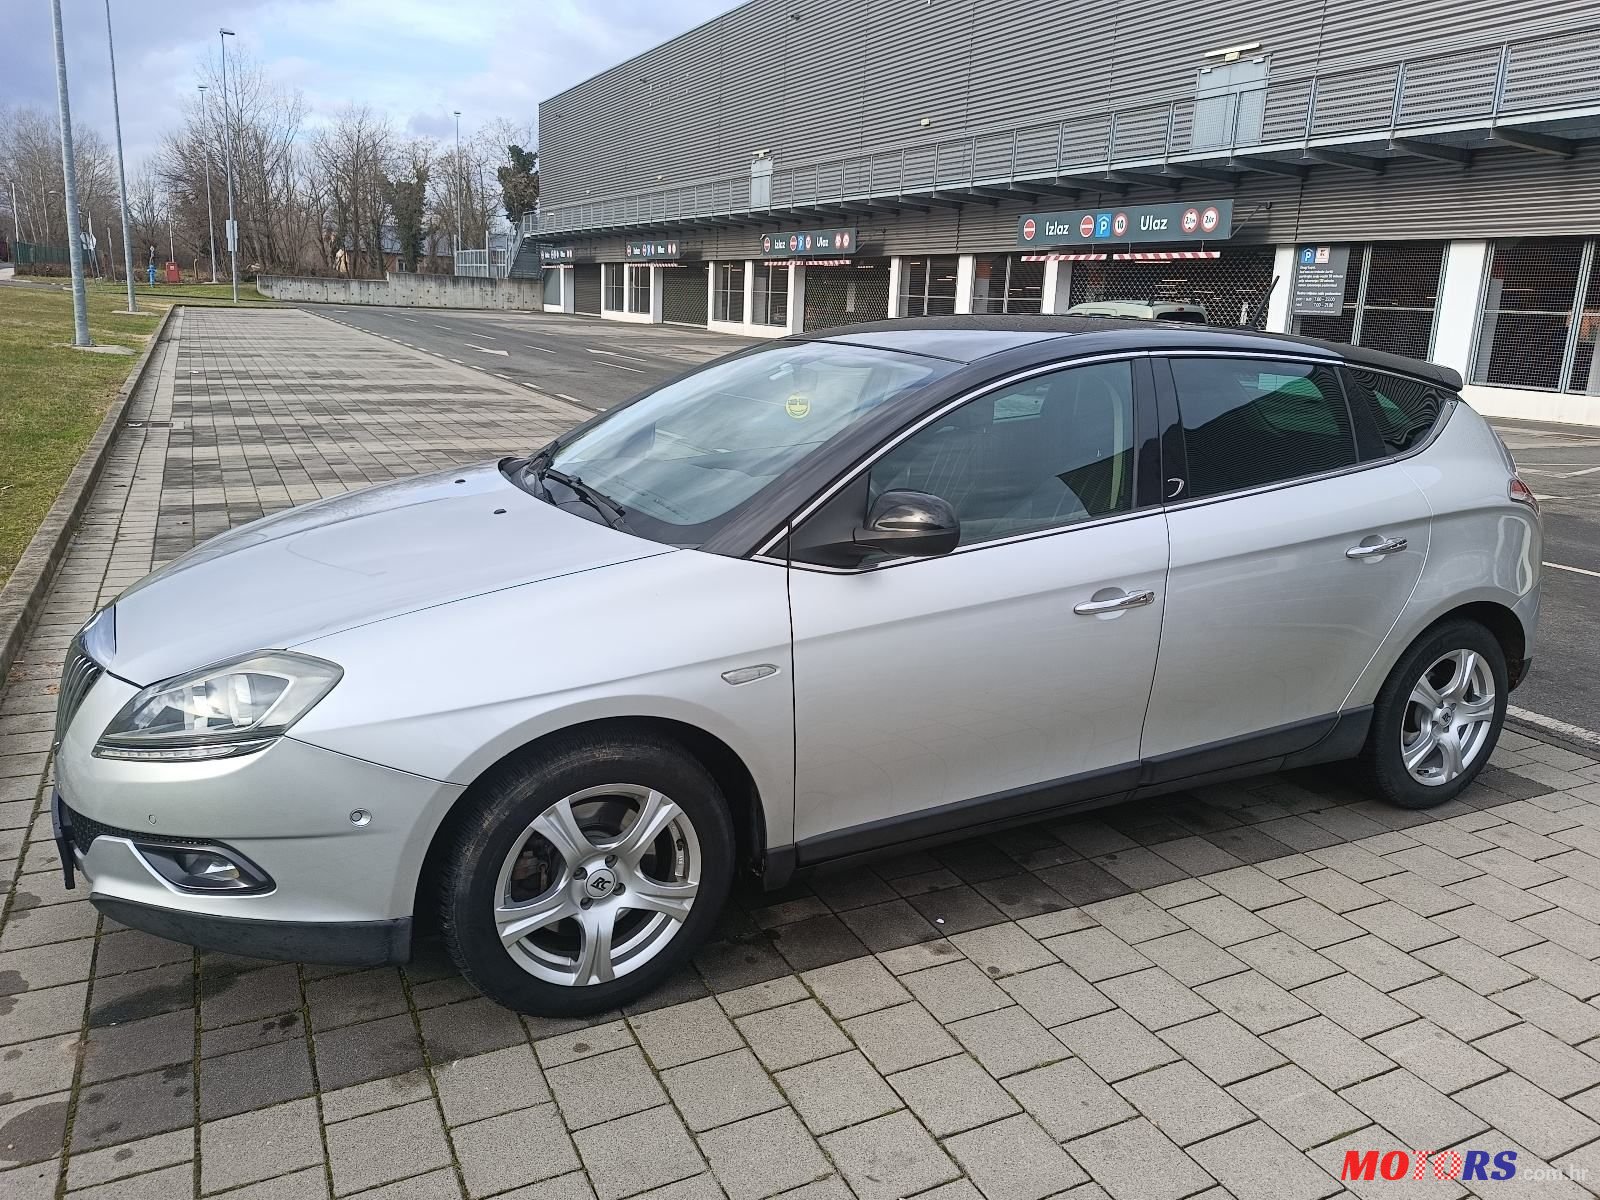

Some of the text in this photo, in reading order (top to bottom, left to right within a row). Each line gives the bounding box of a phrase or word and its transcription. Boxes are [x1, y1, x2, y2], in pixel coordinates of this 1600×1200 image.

[1045, 221, 1070, 236] Izlaz
[1140, 215, 1168, 231] Ulaz
[590, 876, 612, 892] RC
